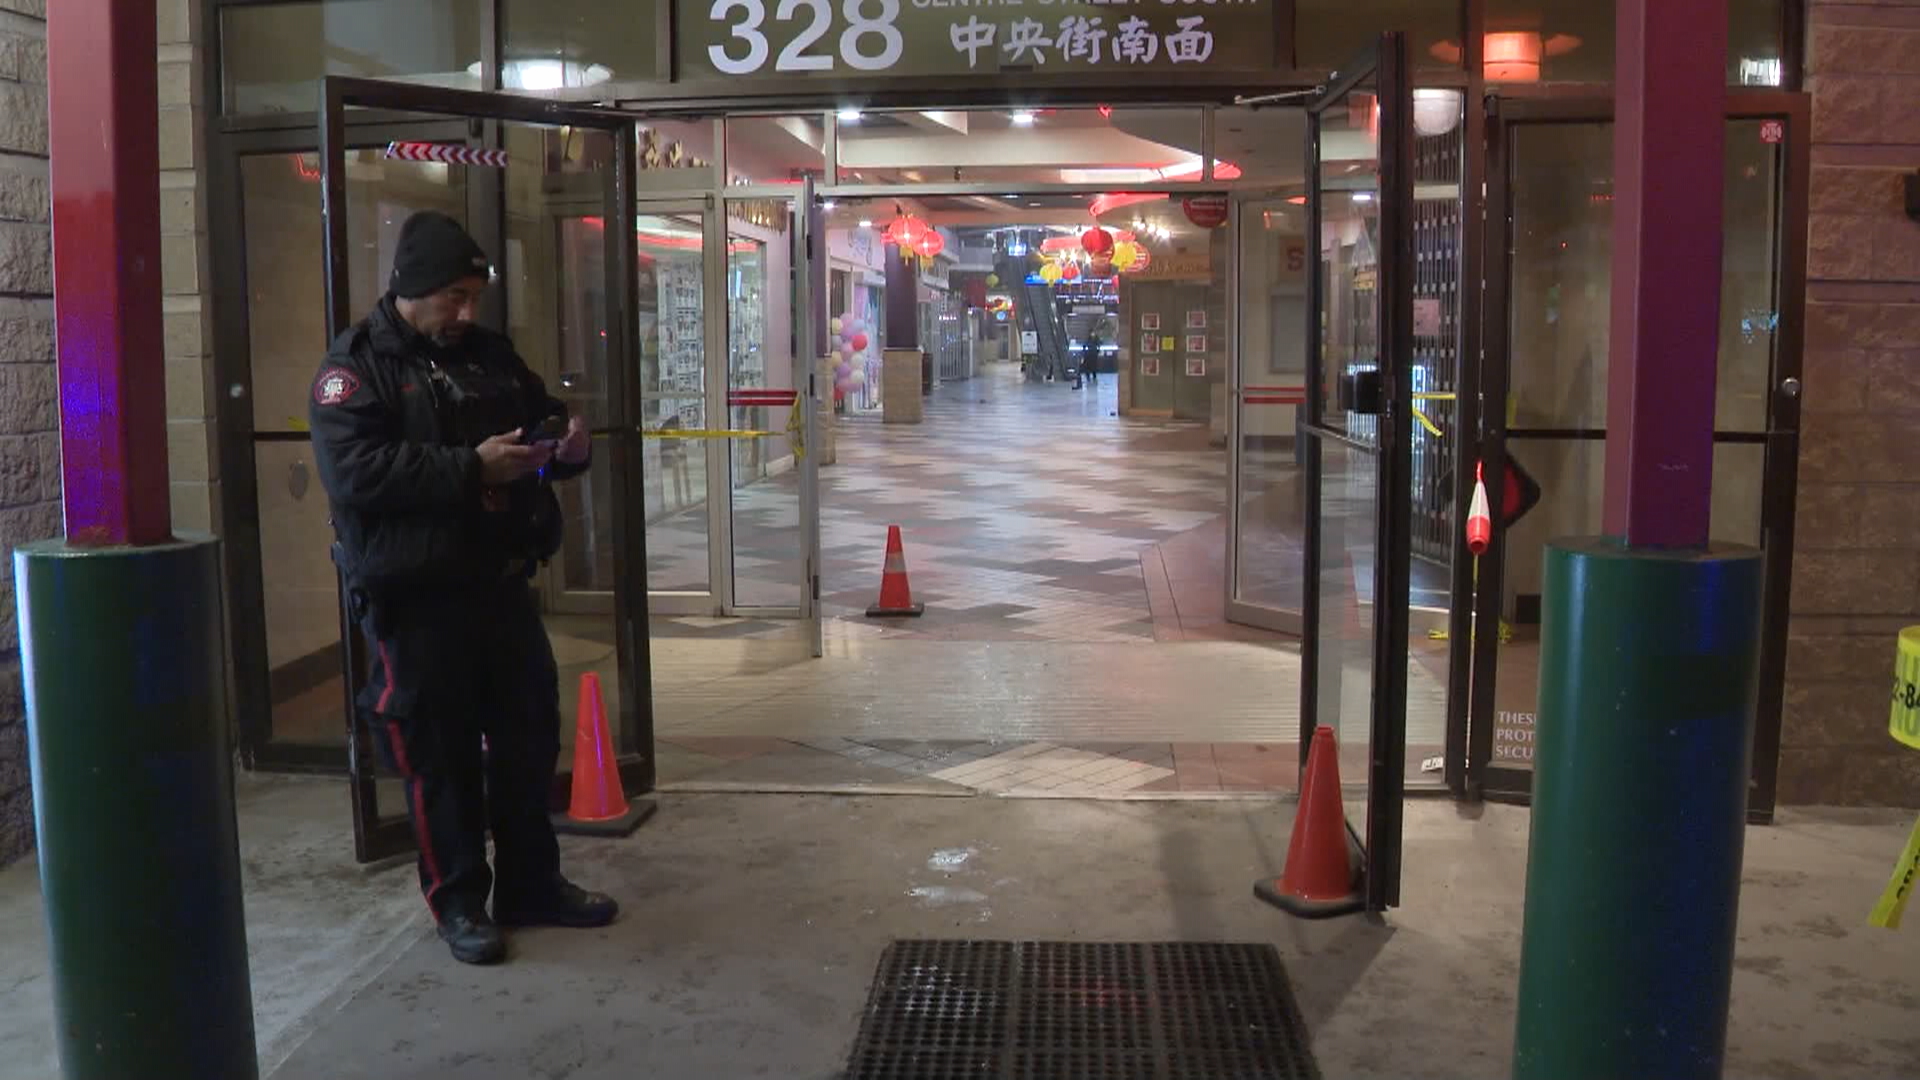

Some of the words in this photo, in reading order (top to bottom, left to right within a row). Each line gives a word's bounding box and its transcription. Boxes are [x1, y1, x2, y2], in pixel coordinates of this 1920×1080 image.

[708, 0, 903, 74] 328
[950, 15, 1213, 68] 中央街南面
[1497, 711, 1536, 725] THES
